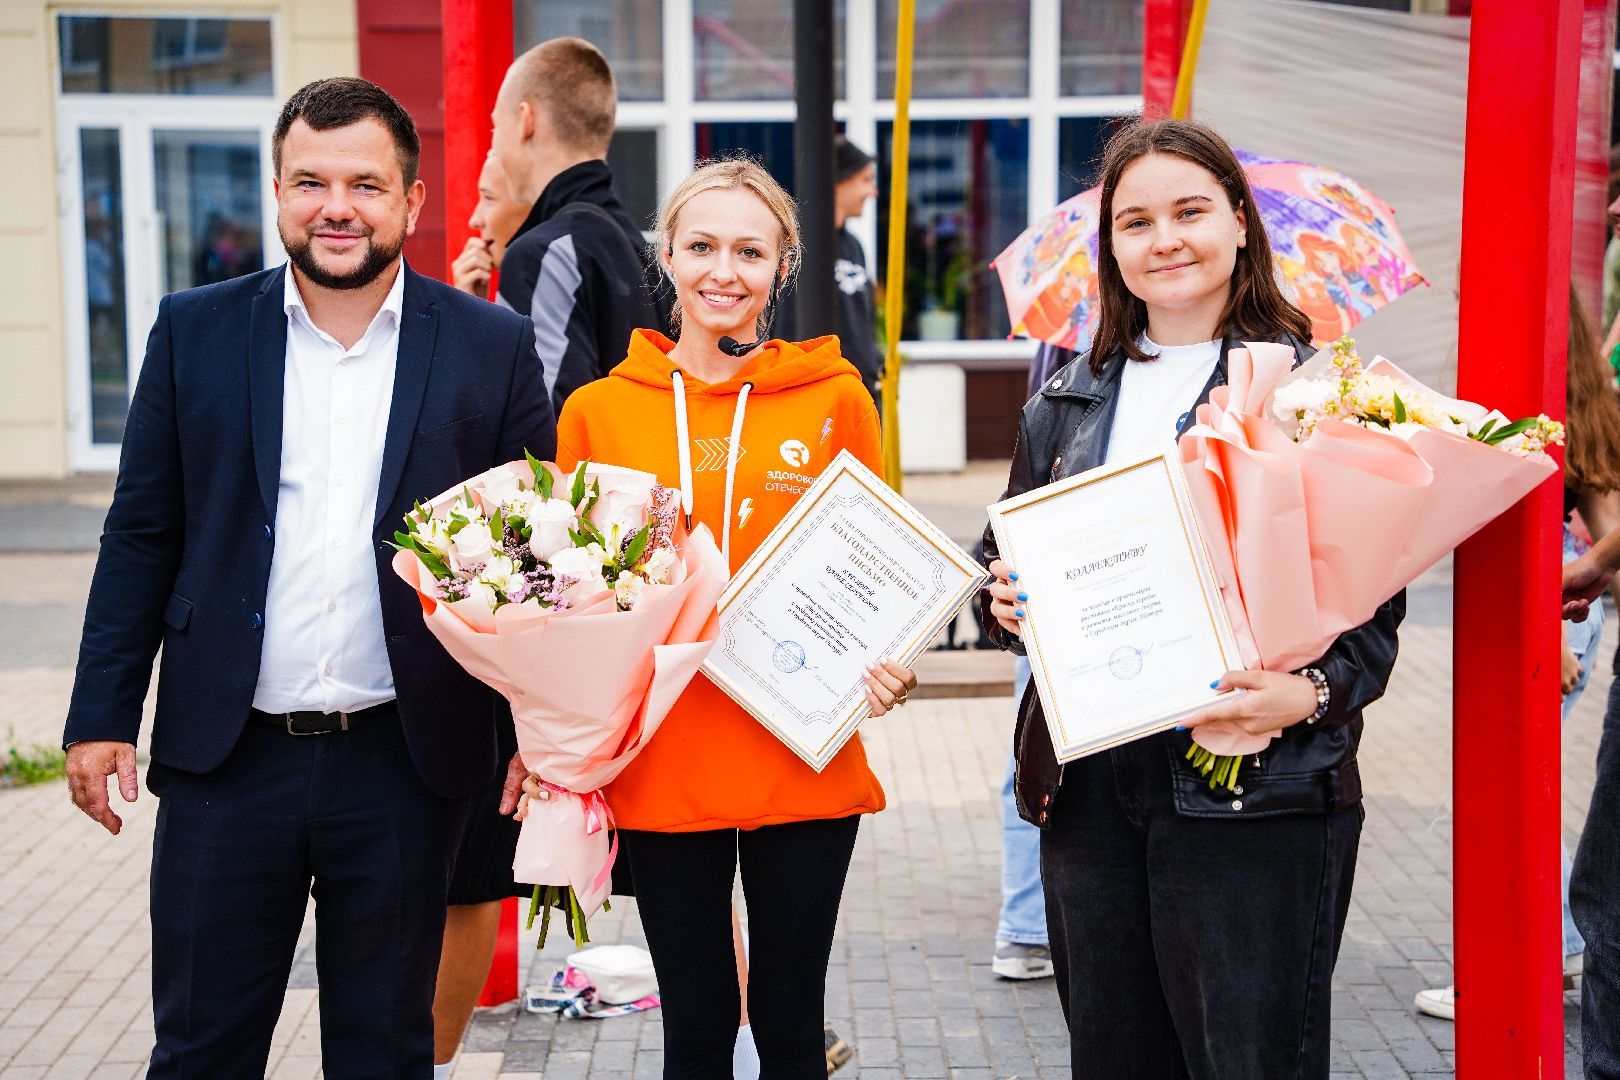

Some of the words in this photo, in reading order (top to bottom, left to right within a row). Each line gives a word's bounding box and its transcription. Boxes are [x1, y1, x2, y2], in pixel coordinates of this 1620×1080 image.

[765, 482, 811, 495] ОТЕЧЕС
[829, 521, 920, 601] БЛАГОДАРСТВЕННОЕ
[847, 552, 887, 588] ПИСЬМО
[1064, 543, 1149, 580] КОЛЛЕКТИВУ
